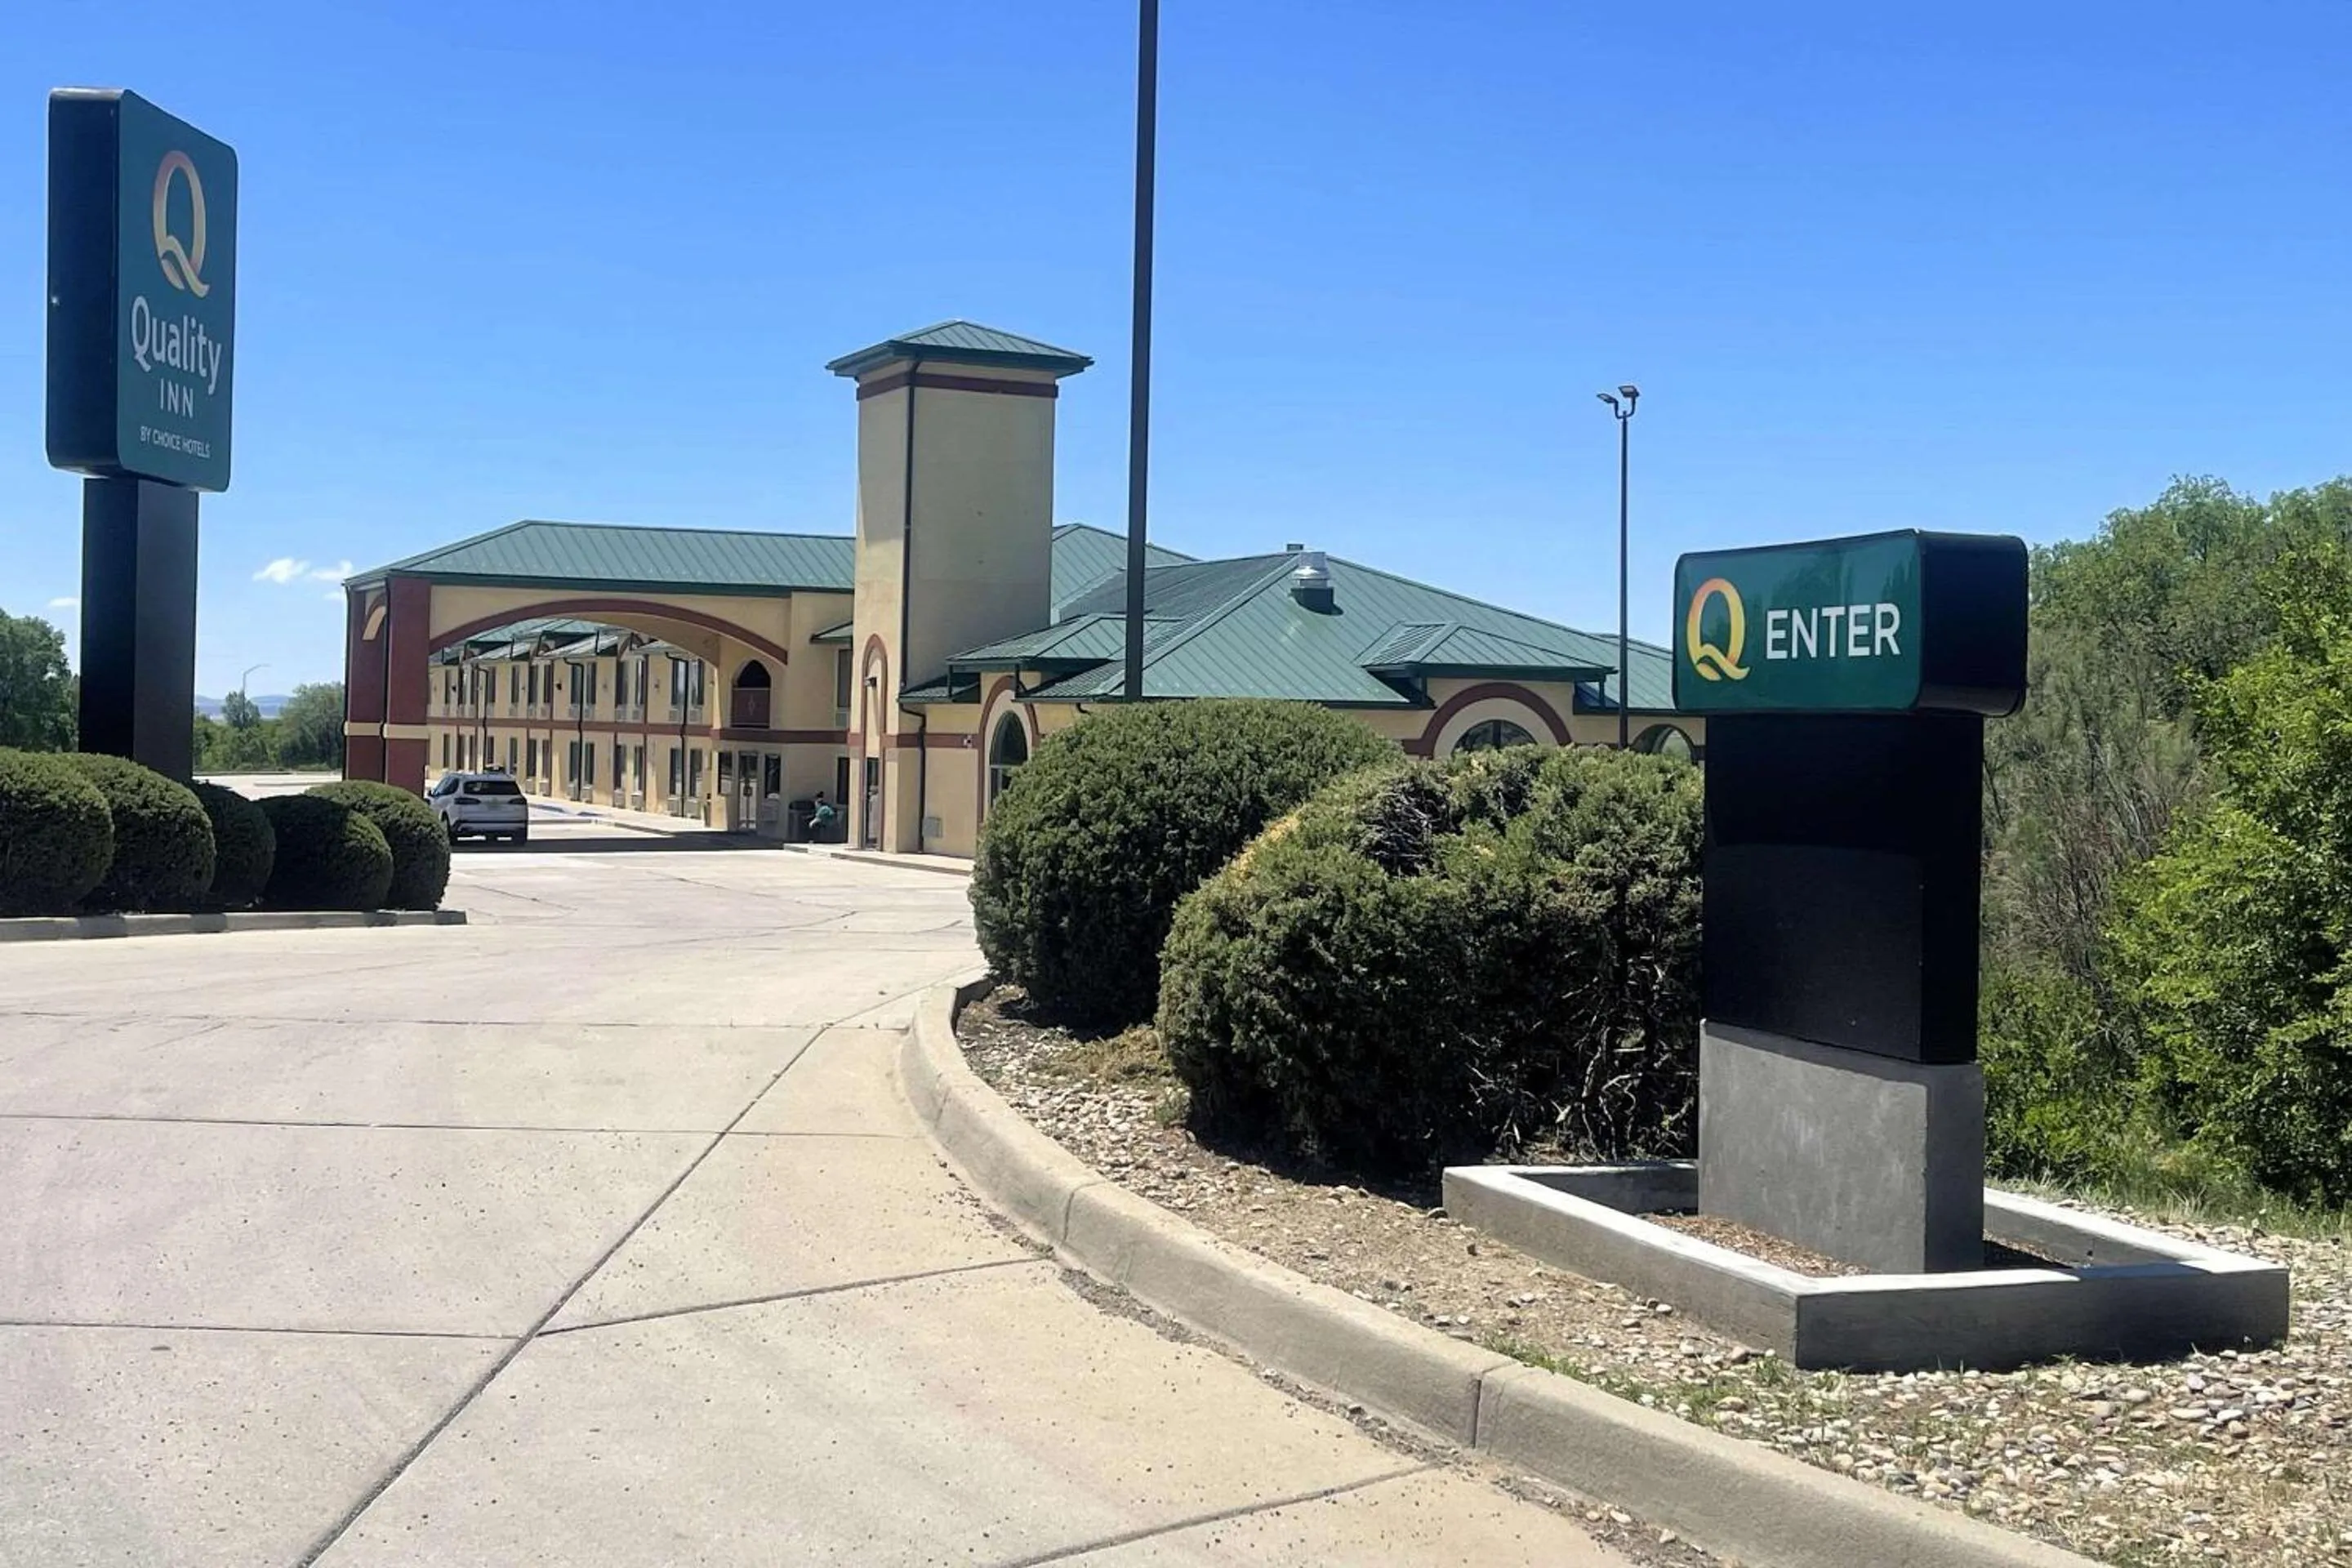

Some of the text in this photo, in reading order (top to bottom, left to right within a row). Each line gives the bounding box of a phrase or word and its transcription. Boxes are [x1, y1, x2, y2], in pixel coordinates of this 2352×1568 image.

[153, 149, 210, 298] Q
[131, 295, 222, 395] Quality
[140, 425, 211, 459] BY CHOICE HOTELS
[160, 377, 194, 419] INN
[1686, 577, 1902, 681] Q ENTER
